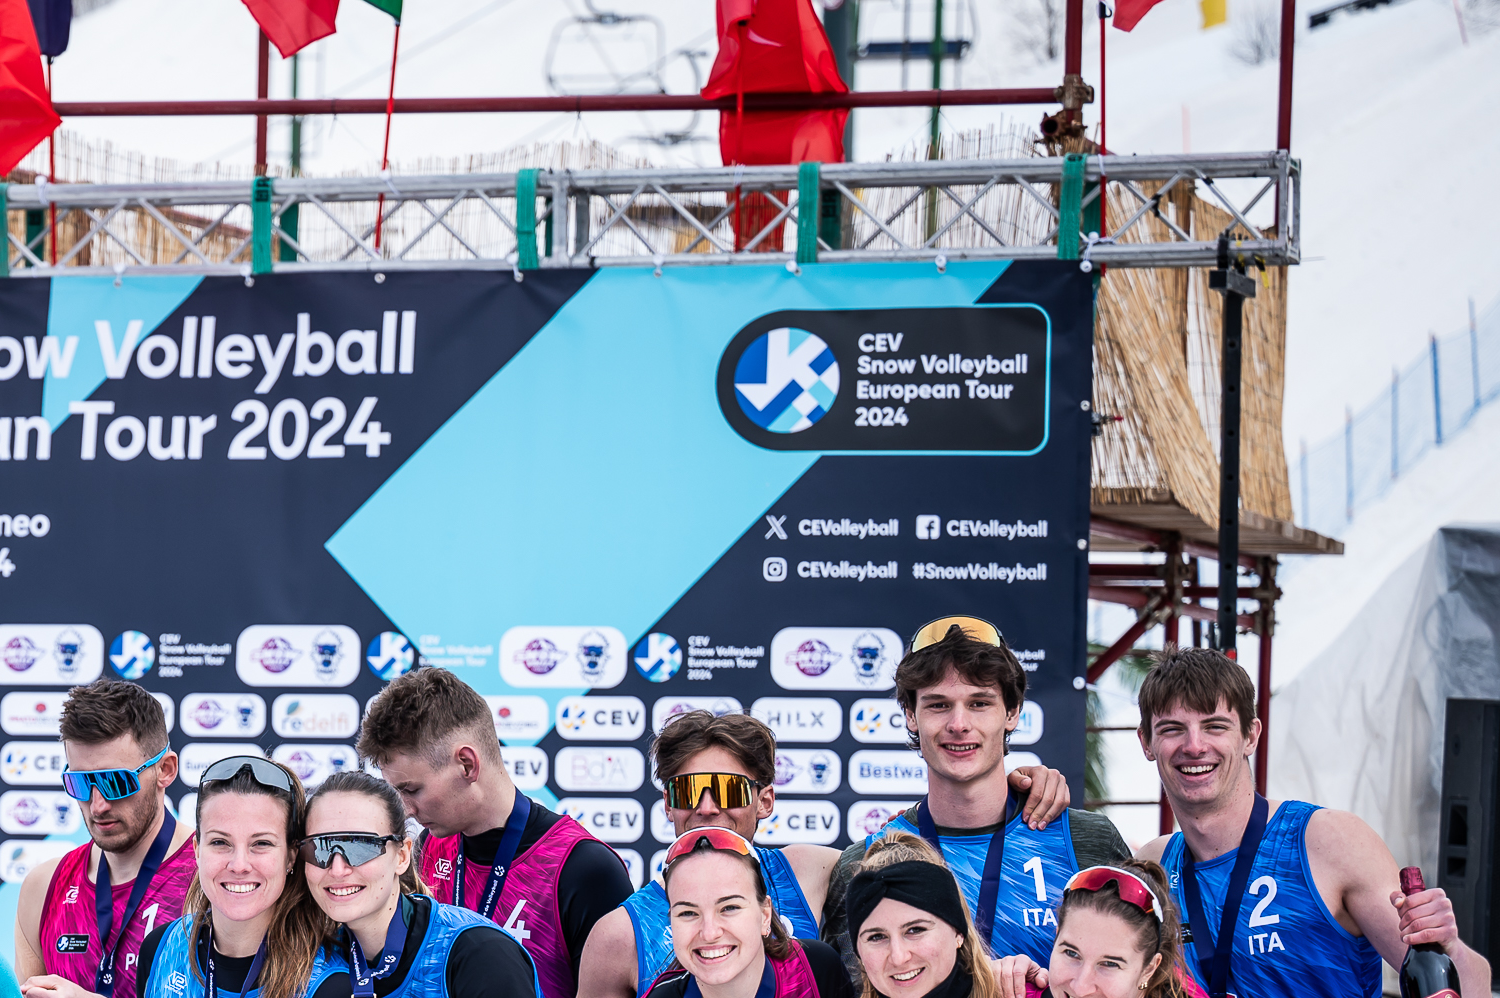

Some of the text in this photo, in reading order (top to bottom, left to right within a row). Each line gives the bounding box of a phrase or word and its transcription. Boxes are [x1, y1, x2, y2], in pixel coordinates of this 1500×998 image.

[94, 310, 416, 394] Volleyball
[858, 333, 903, 352] CEV
[857, 354, 1028, 378] Snow Volleyball
[856, 379, 1014, 403] European Tour
[855, 407, 909, 427] 2024
[68, 400, 218, 461] Tour
[227, 397, 391, 460] 2024
[798, 519, 899, 540] CEVolleyball
[947, 519, 1048, 541] CEVolleyball
[797, 561, 898, 582] CEVolleyball
[912, 562, 1048, 583] #SnowVolleyball
[688, 636, 709, 646] CEV
[688, 646, 764, 659] Snow Volleyball
[688, 658, 757, 670] European Tour
[281, 711, 349, 732] redelfi
[594, 710, 639, 726] CEV
[34, 756, 60, 771] CE
[593, 813, 638, 828] CEV
[787, 815, 834, 830] CEV
[1023, 857, 1047, 902] 1
[1249, 876, 1279, 927] 2
[141, 902, 159, 938] 1
[503, 900, 531, 941] 4
[1023, 908, 1057, 927] ITA
[1248, 931, 1285, 955] ITA
